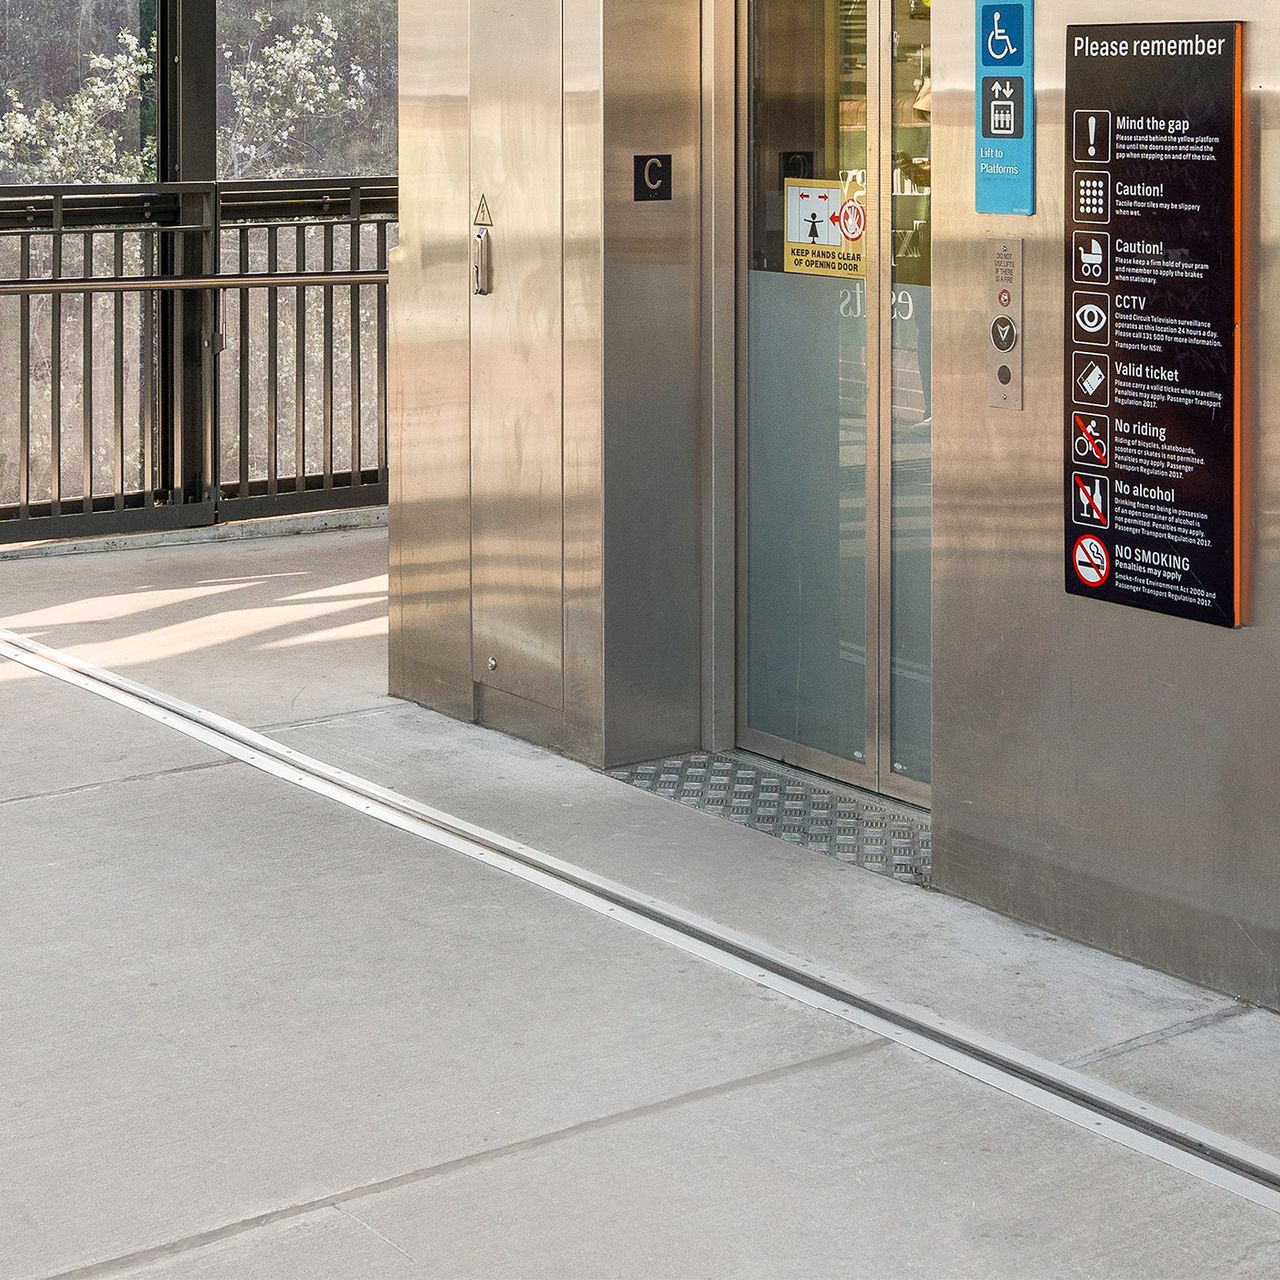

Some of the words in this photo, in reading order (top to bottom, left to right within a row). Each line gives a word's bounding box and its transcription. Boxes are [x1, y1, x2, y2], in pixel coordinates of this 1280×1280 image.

[1074, 36, 1129, 57] Please
[1133, 34, 1226, 56] remember
[1116, 116, 1144, 130] Mind
[1146, 116, 1166, 131] the
[1167, 119, 1190, 134] gap
[980, 147, 994, 159] Lift
[995, 148, 1004, 159] to
[643, 157, 663, 191] C
[980, 162, 1019, 175] Platforms
[1115, 181, 1164, 197] Caution!
[791, 248, 810, 257] KEEP
[811, 249, 836, 260] HANDS
[837, 251, 862, 262] CLEAR
[1115, 238, 1163, 255] Caution!
[794, 258, 803, 267] OF
[805, 259, 836, 270] OPENING
[837, 261, 859, 272] DOOR
[1115, 294, 1147, 311] CCTV
[1115, 312, 1132, 320] Closed
[1133, 314, 1150, 322] Circuit
[1151, 316, 1178, 325] Television
[1178, 319, 1211, 328] surveillance
[1115, 322, 1137, 330] operates
[1156, 325, 1178, 334] location
[1186, 328, 1202, 336] hours
[1208, 330, 1218, 338] day.
[1115, 341, 1140, 350] Transport
[1140, 342, 1148, 350] for
[1149, 344, 1162, 352] NSW.
[1143, 332, 1152, 340] 131
[1154, 333, 1164, 341] 500
[1165, 334, 1173, 342] for
[1174, 336, 1187, 344] more
[1188, 336, 1222, 348] information.
[1115, 361, 1143, 378] Valid
[1145, 364, 1179, 382] ticket
[1115, 379, 1131, 388] Please
[1132, 381, 1146, 390] carry
[1151, 384, 1164, 392] valid
[1164, 384, 1180, 393] ticket
[1180, 387, 1195, 396] when
[1196, 389, 1222, 400] travelling.
[1115, 388, 1138, 397] Penalties
[1139, 391, 1150, 400] may
[1150, 392, 1166, 402] apply.
[1167, 394, 1194, 405] Passenger
[1194, 397, 1221, 408] Transport
[1115, 396, 1142, 406] Regulation
[1143, 400, 1158, 408] 2017.
[1115, 418, 1130, 434] No
[1133, 421, 1167, 442] riding
[1115, 436, 1130, 446] Riding
[1138, 439, 1160, 450] bicycles,
[1162, 443, 1196, 455] skateboards,
[1115, 446, 1136, 454] scooters
[1144, 448, 1160, 458] skates
[1177, 454, 1206, 465] permitted.
[1115, 453, 1138, 462] Penalties
[1139, 458, 1150, 466] may
[1150, 458, 1166, 468] apply.
[1166, 462, 1194, 472] Passenger
[1115, 462, 1140, 472] Transport
[1140, 466, 1168, 476] Regulation
[1168, 470, 1184, 480] 2017.
[1115, 479, 1130, 495] No
[1133, 483, 1175, 503] alcohol
[1115, 497, 1136, 508] Drinking
[1137, 501, 1150, 510] from
[1157, 504, 1172, 514] being
[1178, 509, 1208, 520] possession
[1128, 509, 1142, 517] open
[1142, 511, 1168, 520] container
[1175, 516, 1195, 526] alcohol
[1115, 522, 1140, 535] Passenger
[1142, 528, 1167, 539] Transport
[1168, 532, 1196, 544] Regulation
[1196, 538, 1212, 548] 2017.
[1124, 517, 1151, 528] permitted.
[1152, 521, 1177, 532] Penalties
[1178, 526, 1188, 536] may
[1189, 528, 1205, 538] apply.
[1115, 544, 1132, 560] NO
[1134, 548, 1190, 571] SMOKING
[1115, 559, 1146, 573] Penalties
[1147, 566, 1162, 578] may
[1162, 570, 1182, 582] apply
[1115, 572, 1146, 585] Smoke-free
[1146, 578, 1180, 592] Environment
[1180, 584, 1190, 594] Act
[1190, 587, 1205, 596] 2000
[1206, 590, 1216, 600] and
[1115, 580, 1141, 592] Passenger
[1142, 585, 1168, 598] Transport
[1168, 591, 1197, 604] Regulation
[1197, 598, 1212, 608] 2017.
